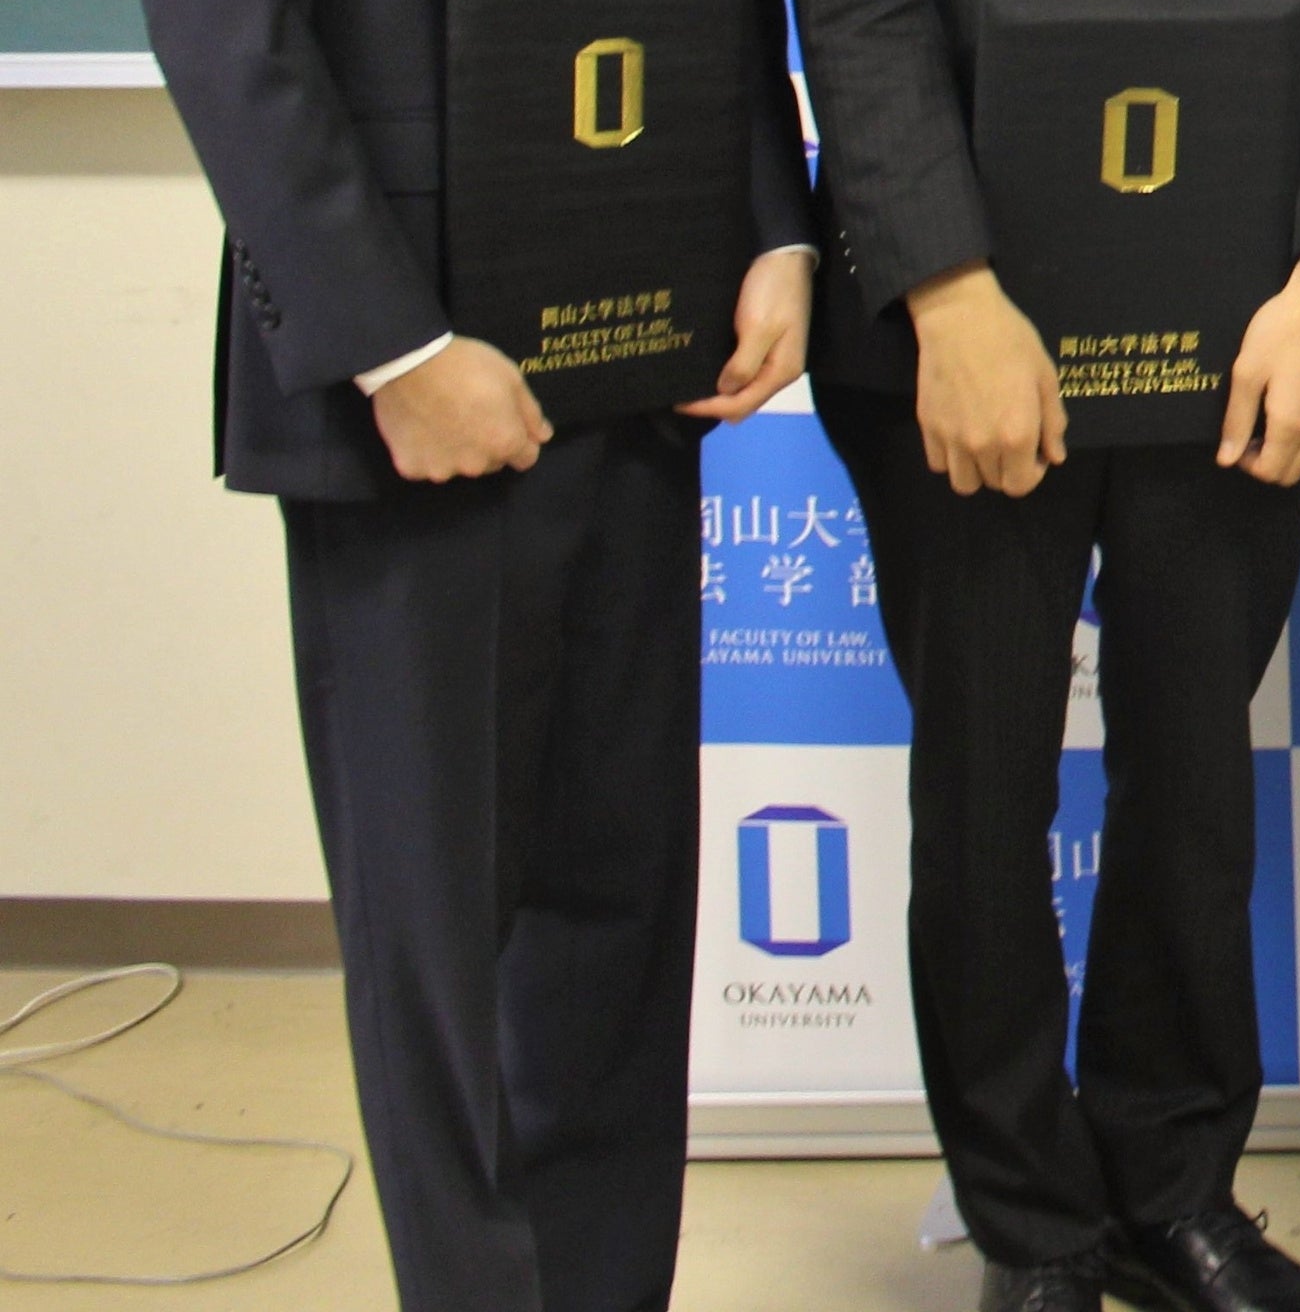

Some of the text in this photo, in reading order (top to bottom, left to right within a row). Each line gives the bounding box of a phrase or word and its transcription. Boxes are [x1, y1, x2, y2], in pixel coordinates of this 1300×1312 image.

[709, 628, 793, 647] FACULTY
[796, 629, 820, 646] OF
[701, 648, 887, 666] AYAMA UNIVERSIT
[722, 981, 873, 1006] OKAYAMA
[739, 1011, 856, 1029] UNIVERSITY
